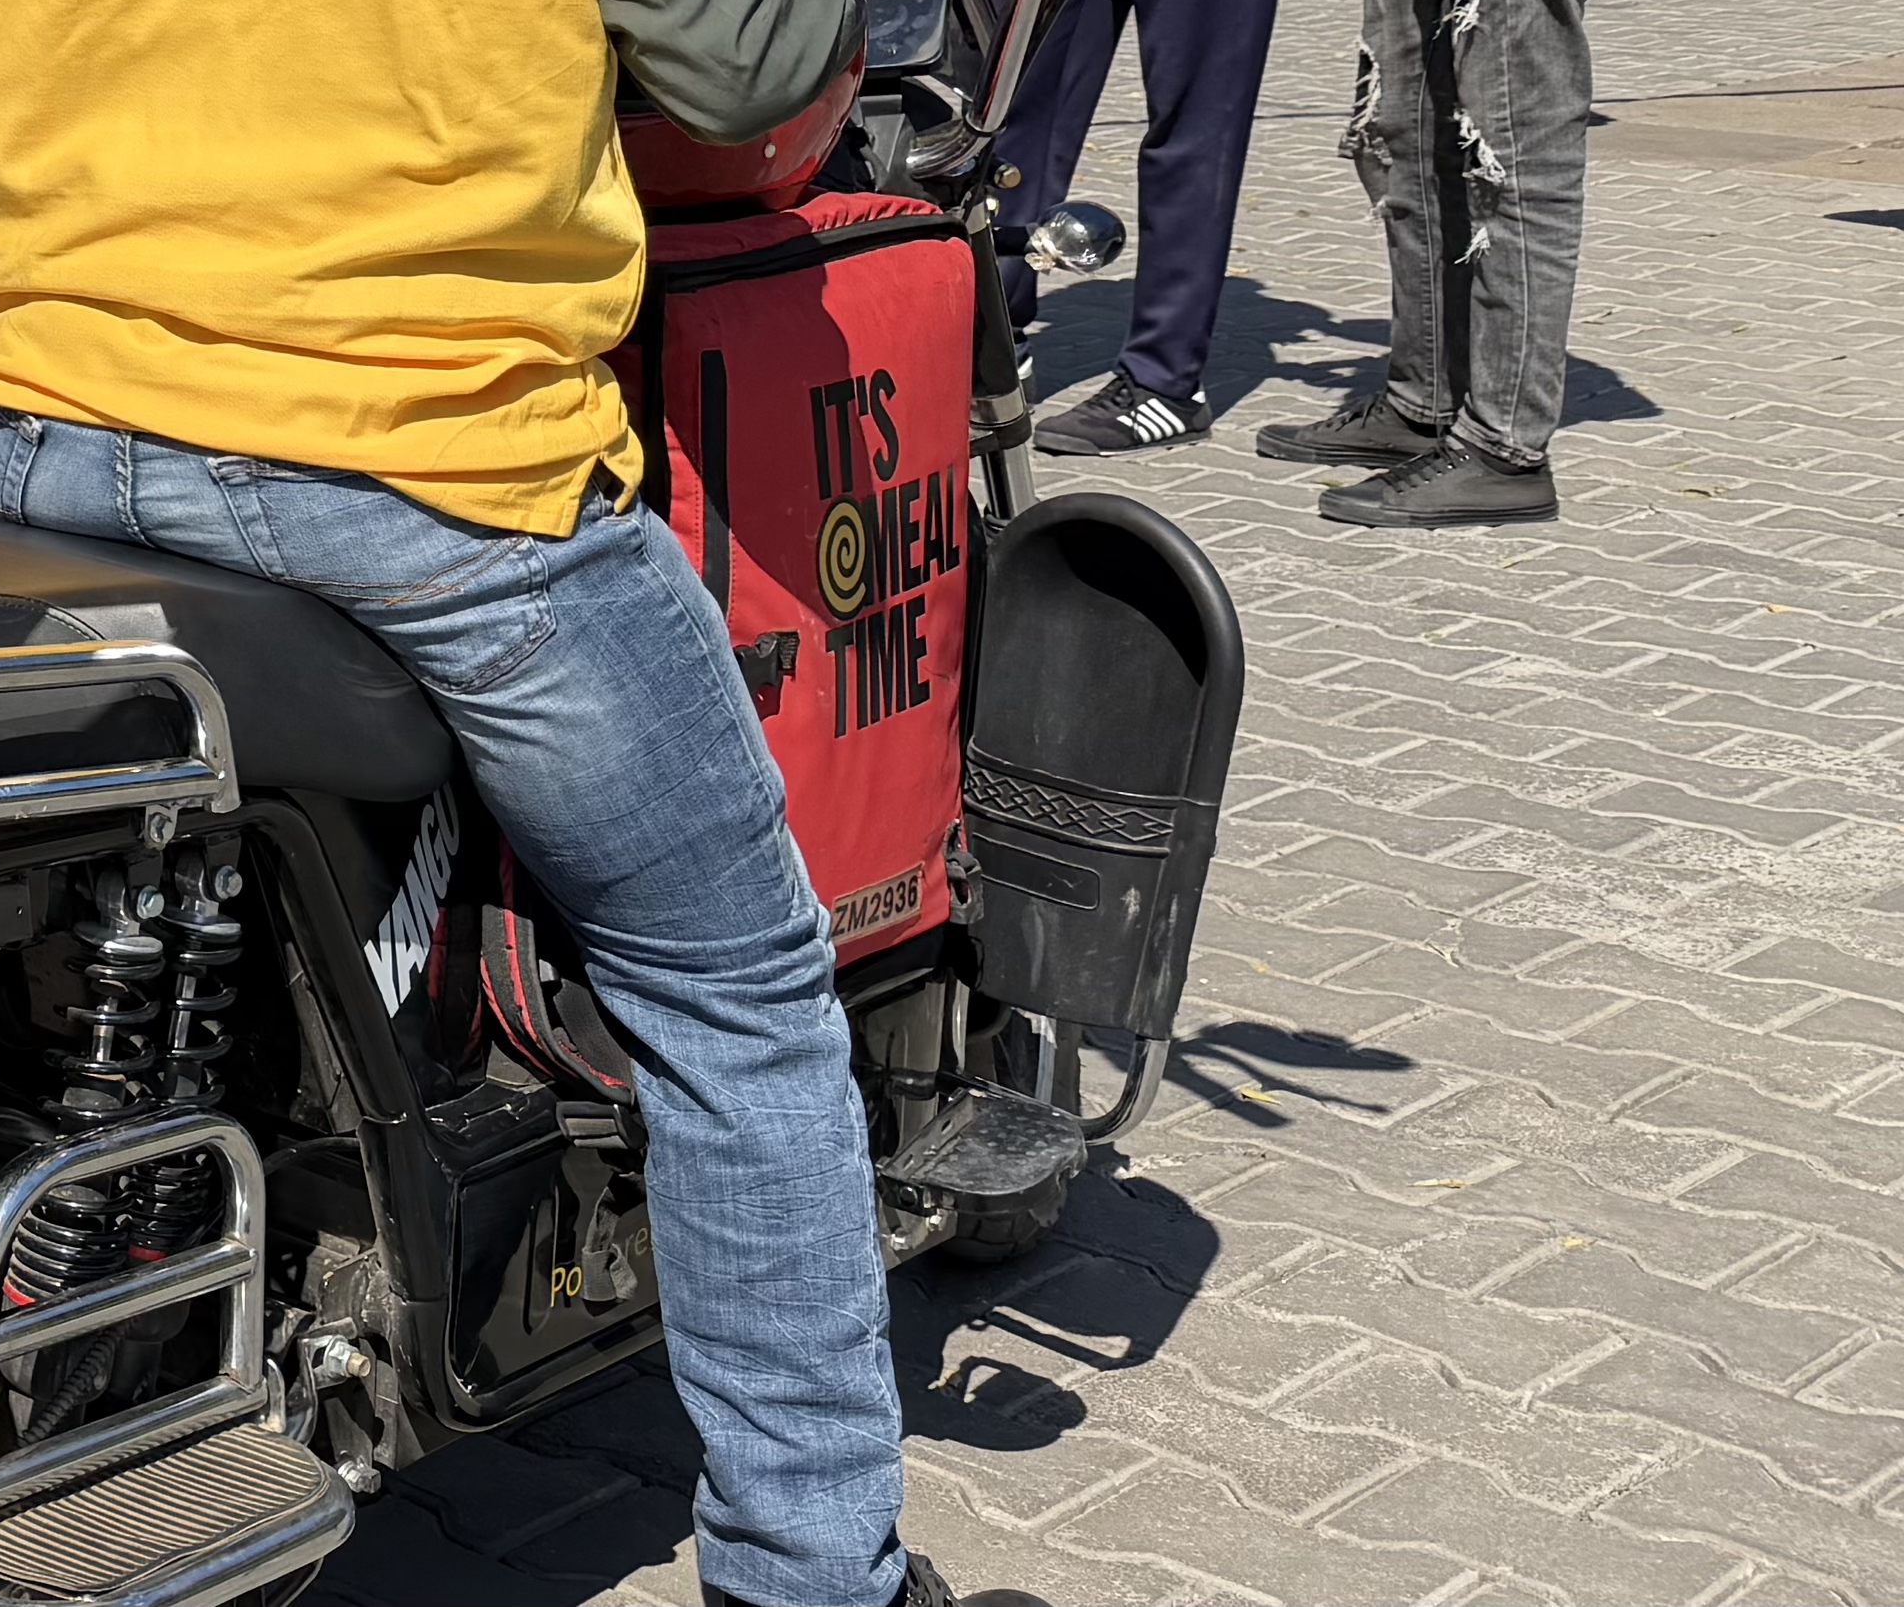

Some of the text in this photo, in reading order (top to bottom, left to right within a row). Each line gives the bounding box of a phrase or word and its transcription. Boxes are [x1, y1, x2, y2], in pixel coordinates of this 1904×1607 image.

[809, 368, 899, 500] IT'S
[863, 463, 961, 607] MEAL
[825, 593, 931, 740] TIME
[364, 780, 460, 1020] YANGO
[832, 874, 919, 937] ZM2936
